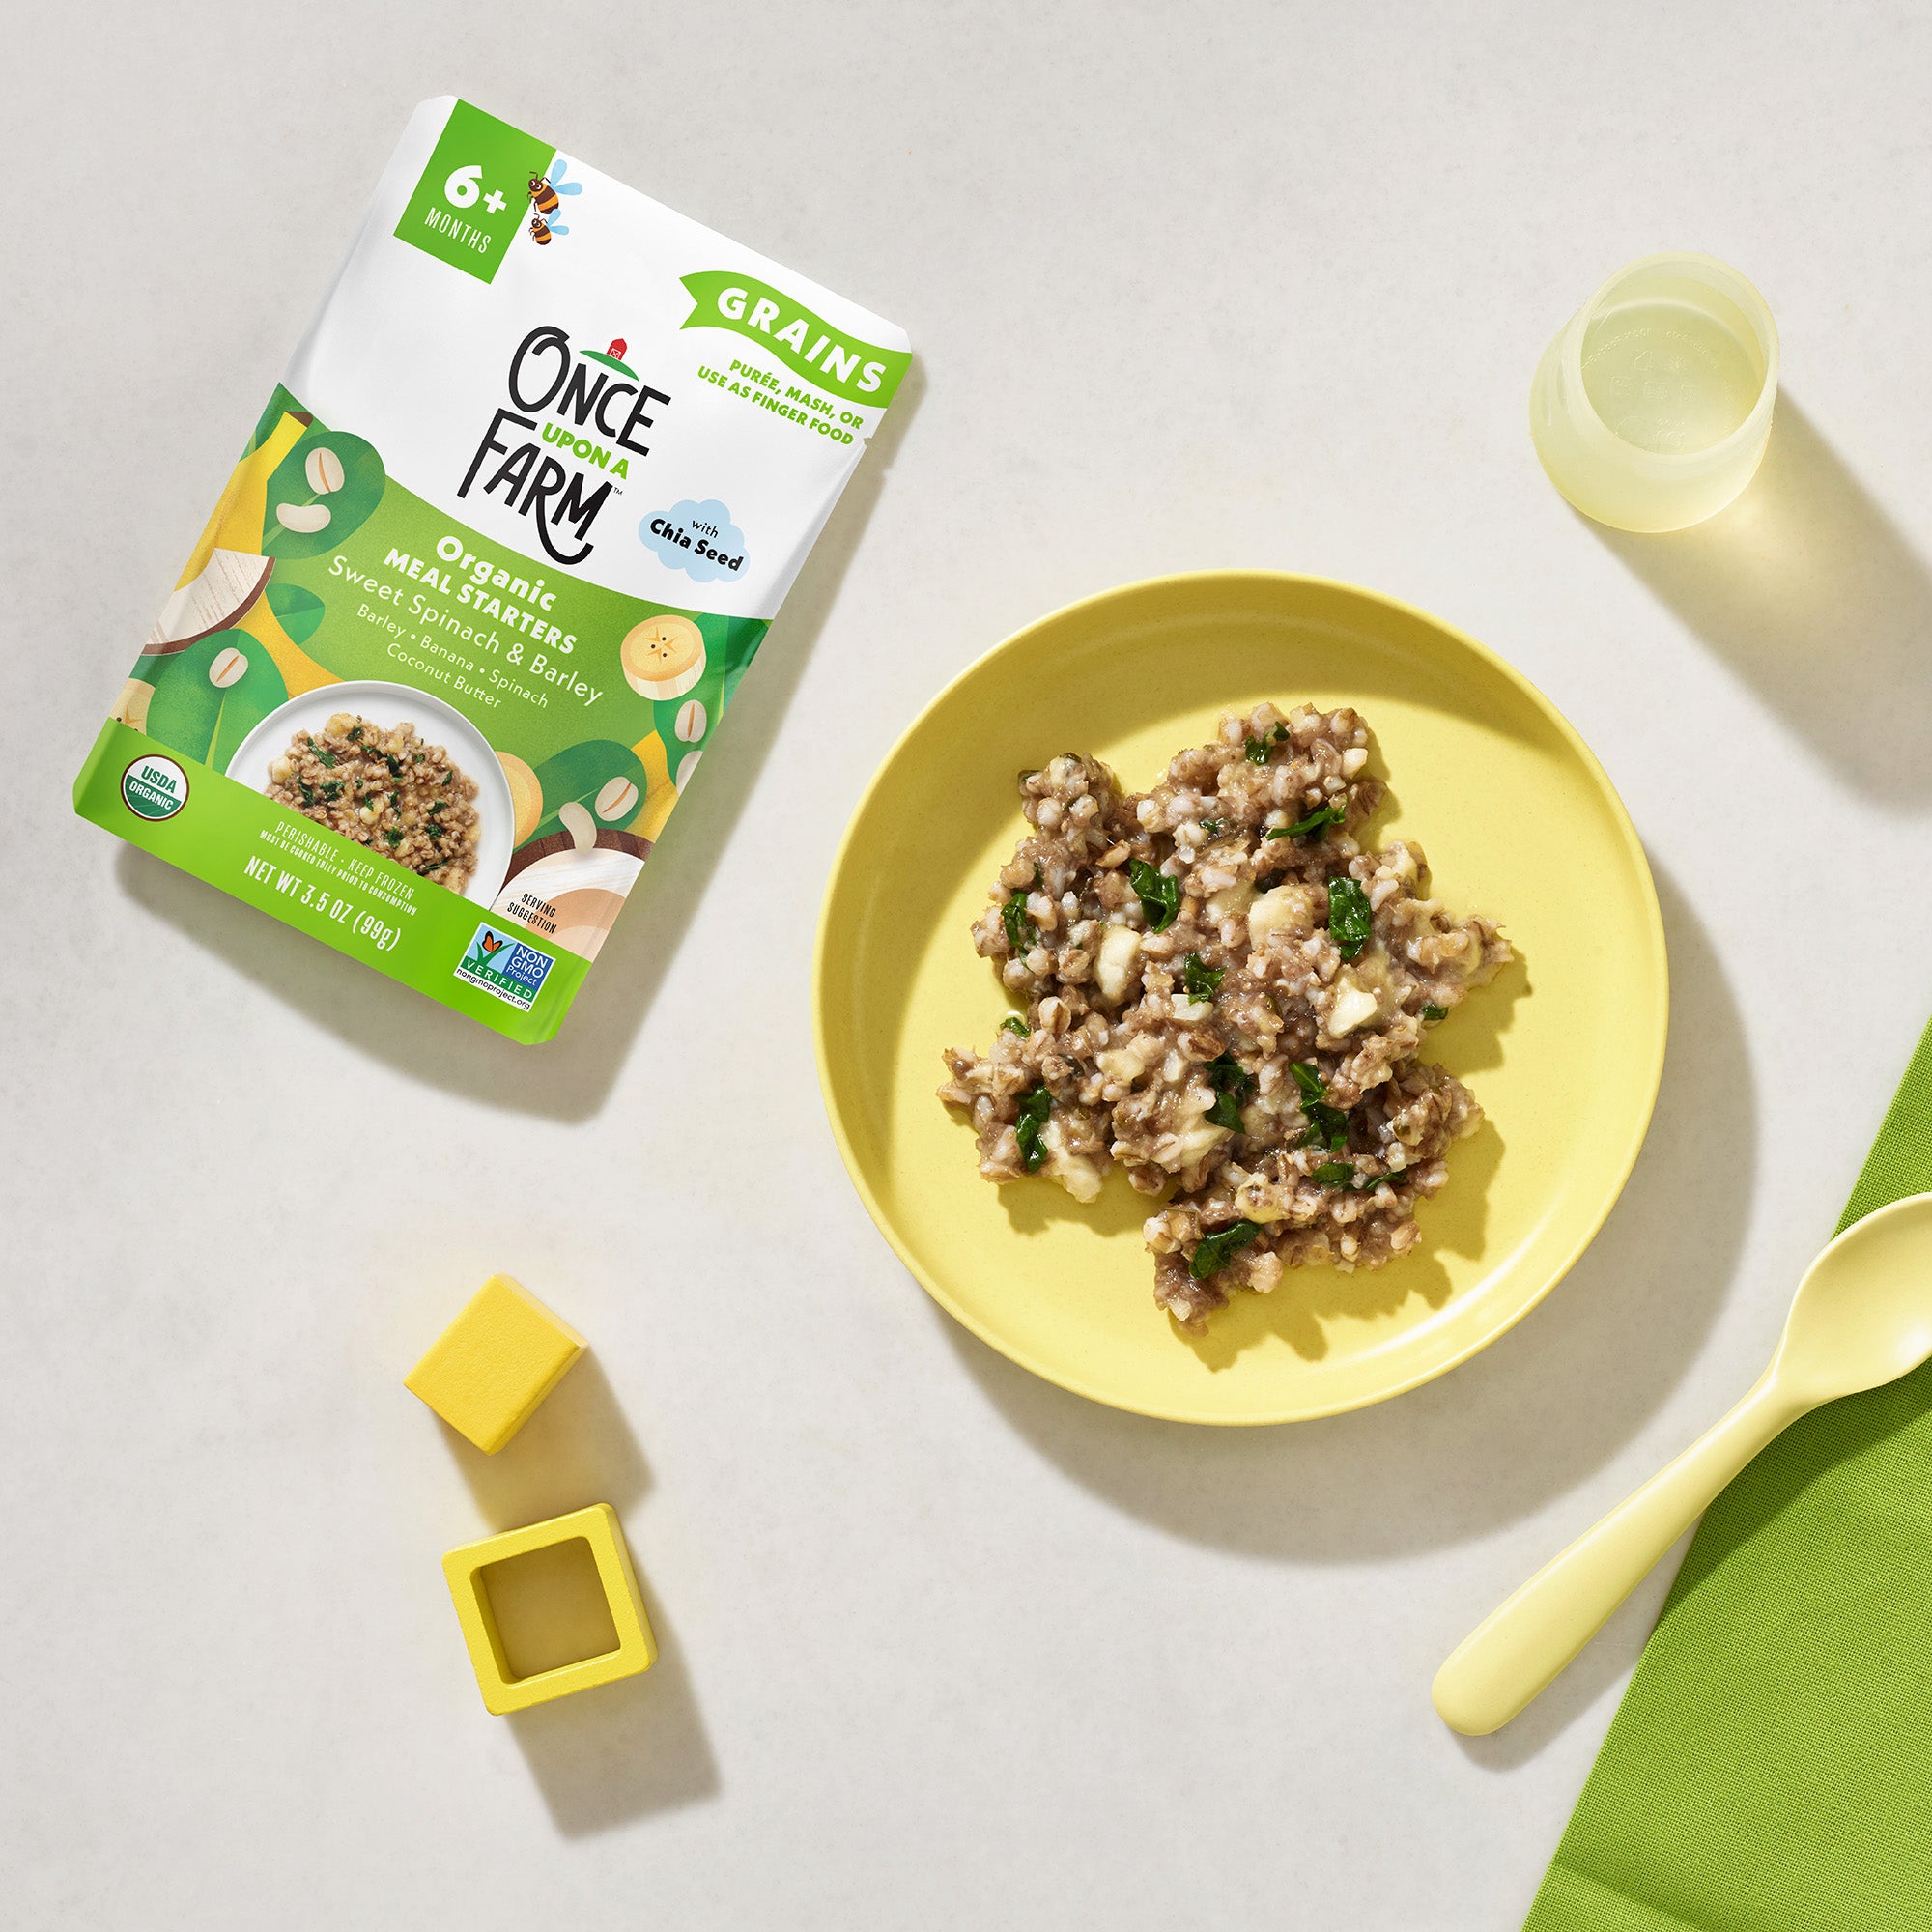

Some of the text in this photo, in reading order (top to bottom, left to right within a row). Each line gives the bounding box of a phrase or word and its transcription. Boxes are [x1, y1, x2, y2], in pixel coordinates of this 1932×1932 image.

[444, 165, 506, 214] 6+
[424, 207, 491, 253] MONTHS
[718, 287, 886, 392] GRAINS
[508, 326, 671, 456] ONCE
[697, 365, 853, 445] USE AS FINGER FOOD
[729, 359, 864, 430] PURÉE, MASH, OR
[542, 422, 629, 480] UPON A
[650, 518, 743, 571] Chia Seed
[692, 520, 719, 538] with
[437, 535, 556, 611] Organic
[384, 548, 578, 654] MEAL STARTERS
[328, 555, 603, 707] Sweet Spinach & Barley
[357, 603, 549, 708] Barley Banana Spinach
[387, 643, 501, 709] Coconut Butter
[129, 781, 173, 810] ORGANIC
[141, 765, 177, 794] USDA
[260, 830, 417, 916] MUST BE COOKED FULLY PRIOR TO CONSUMPTION
[275, 821, 414, 901] PERISHABLE KEEP FROZEN
[244, 856, 400, 952] NET WT 3.5 OZ (99g)
[507, 902, 557, 933] SUGGESTION
[522, 894, 556, 918] SERVING
[467, 960, 532, 999] VERIFIED
[506, 965, 537, 985] Project
[512, 957, 543, 978] GMO
[516, 946, 548, 968] NON
[457, 969, 530, 1010] nongmoproject.org
